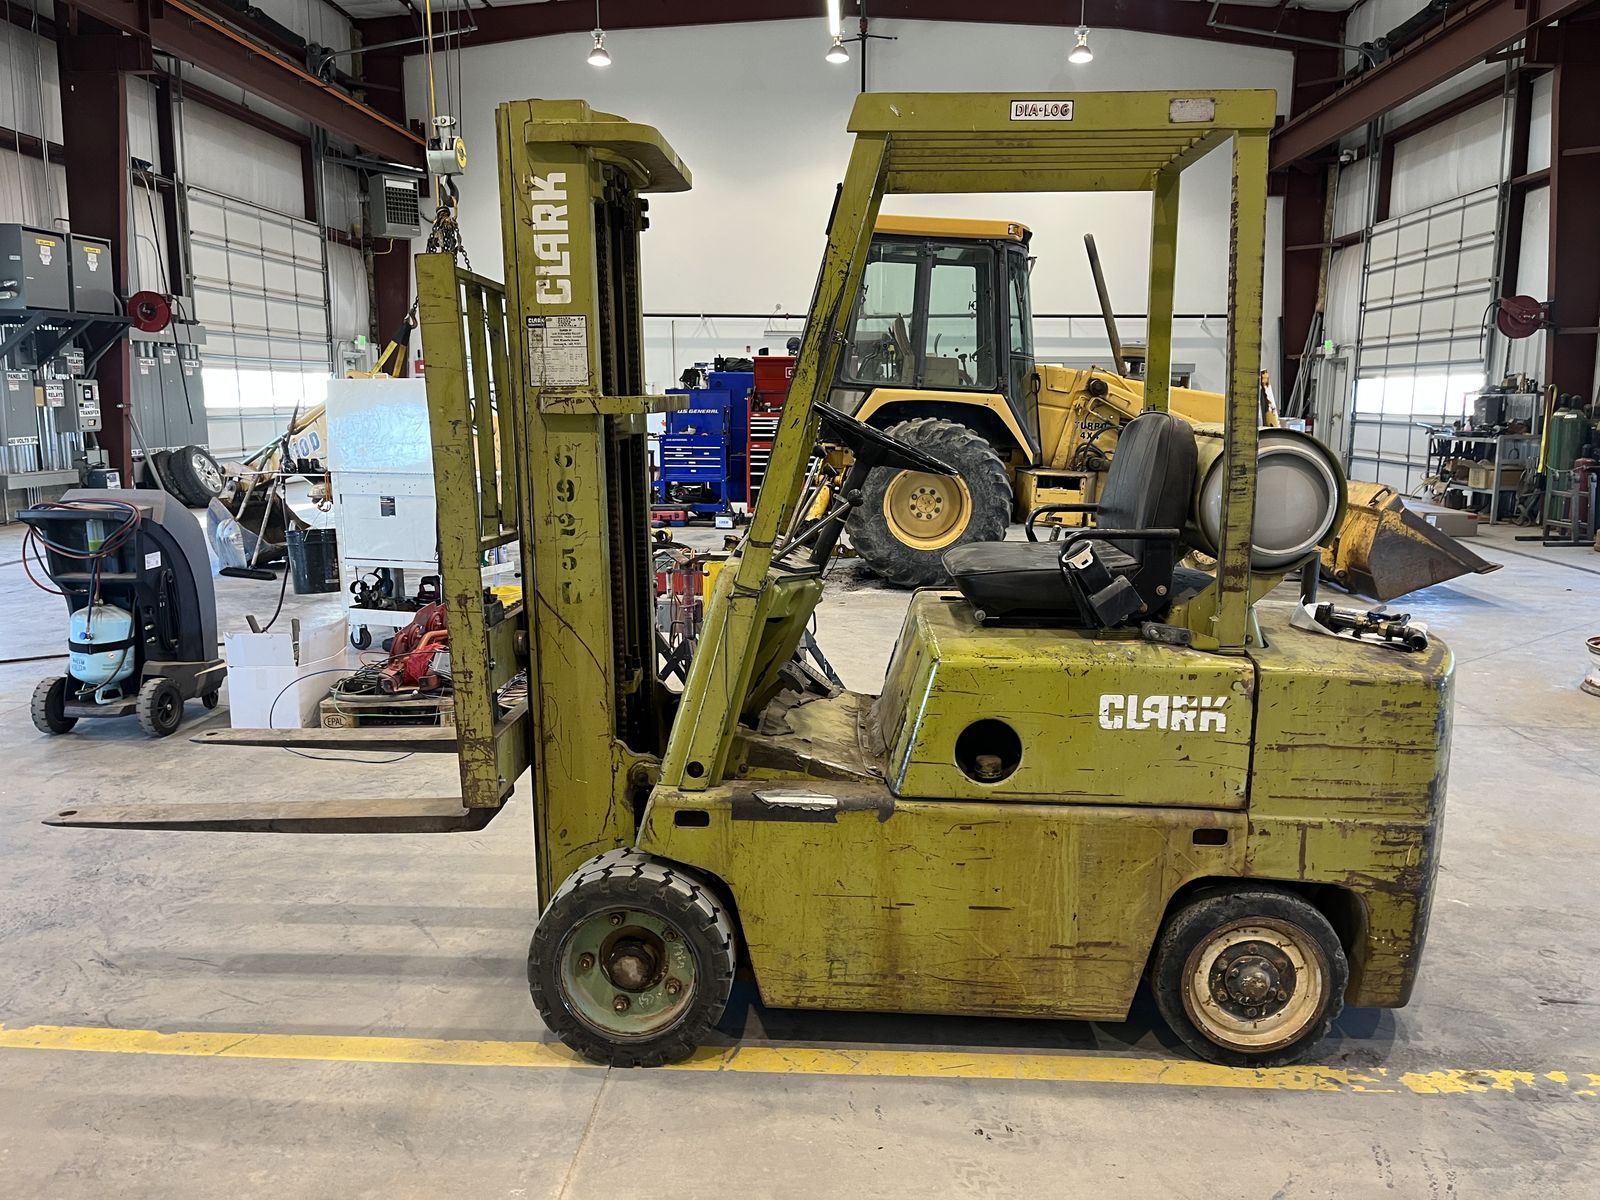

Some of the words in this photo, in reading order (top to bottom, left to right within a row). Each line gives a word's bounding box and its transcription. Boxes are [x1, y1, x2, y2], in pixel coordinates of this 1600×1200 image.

[530, 172, 571, 304] CLARK
[327, 718, 343, 726] EPAL
[1099, 694, 1228, 732] CLARK
